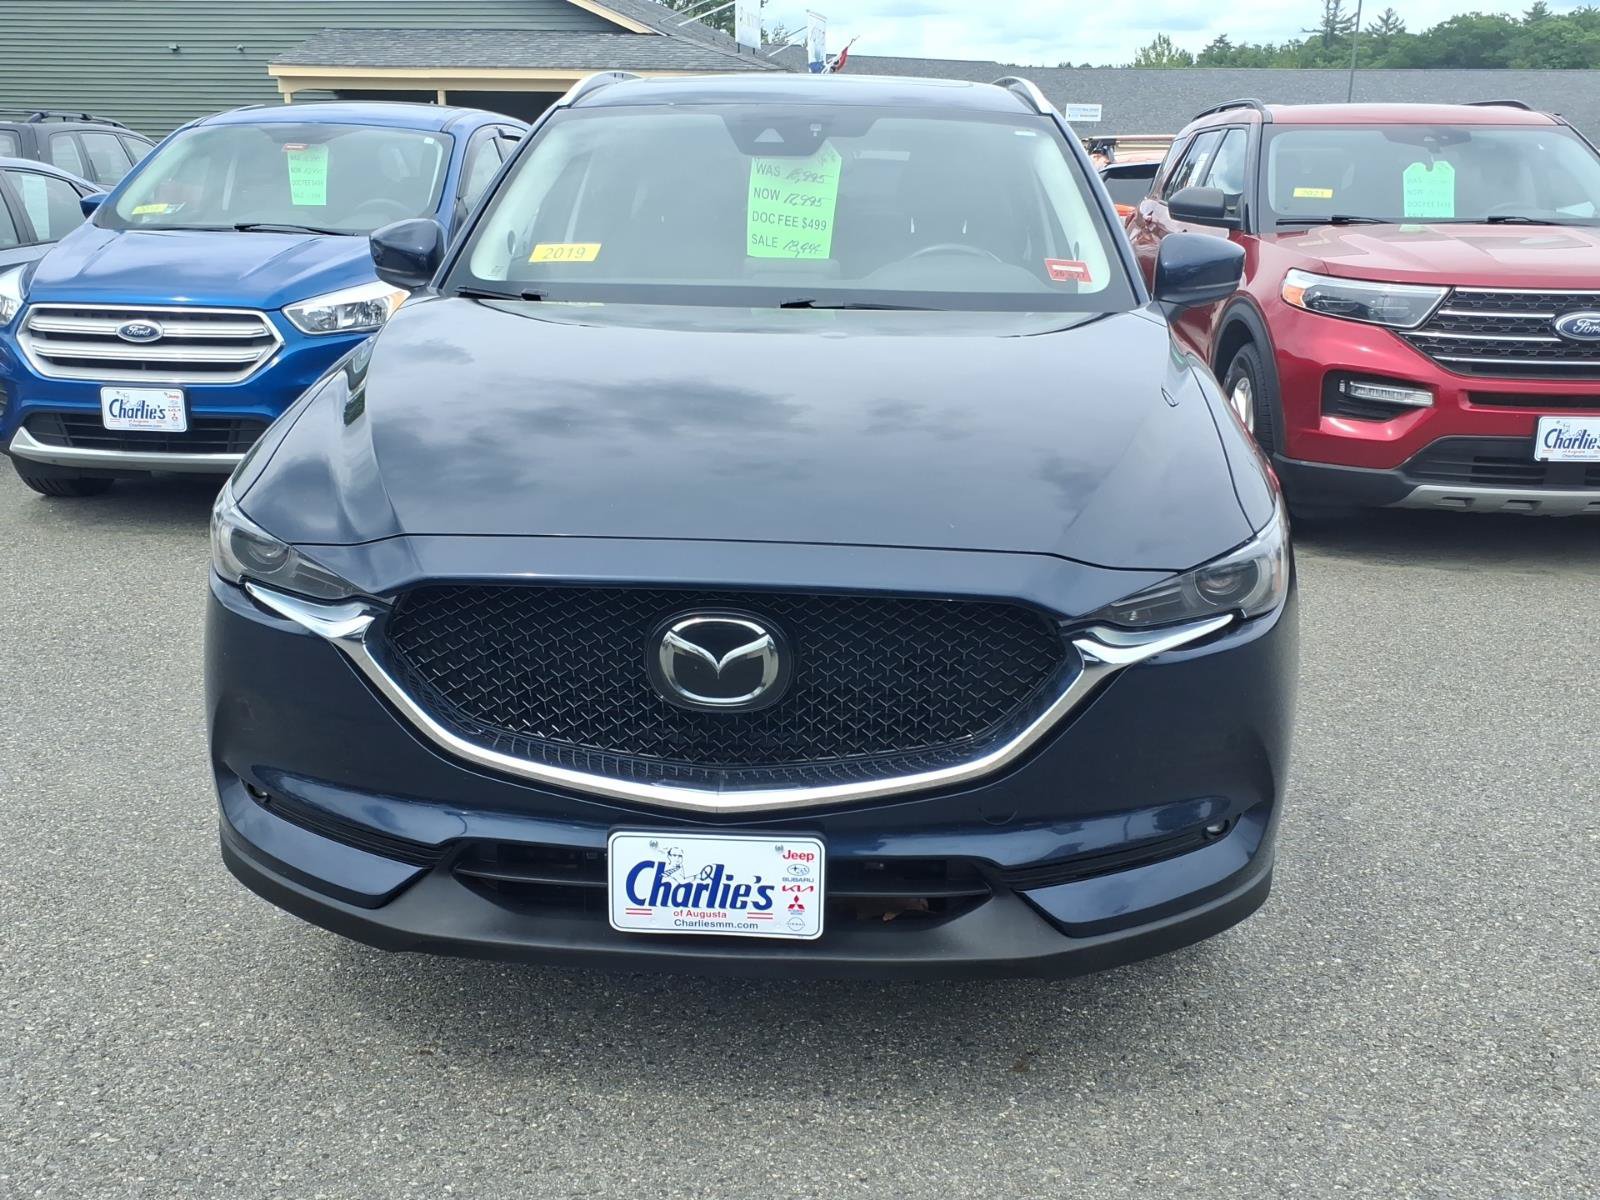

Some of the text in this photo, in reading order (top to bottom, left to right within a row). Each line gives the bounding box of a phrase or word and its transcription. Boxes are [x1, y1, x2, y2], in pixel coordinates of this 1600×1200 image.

[756, 161, 780, 177] WAS
[754, 187, 780, 200] NOW
[752, 210, 827, 231] DOC FEE $499
[751, 234, 778, 248] SALE
[542, 247, 586, 259] 2019
[126, 324, 151, 336] Ford
[1572, 318, 1600, 333] For
[109, 398, 166, 420] Charlie's
[782, 849, 814, 862] Jeep
[625, 860, 775, 911] Charlie's
[673, 909, 727, 920] of Augusta
[674, 919, 759, 930] Charliesmm.com
